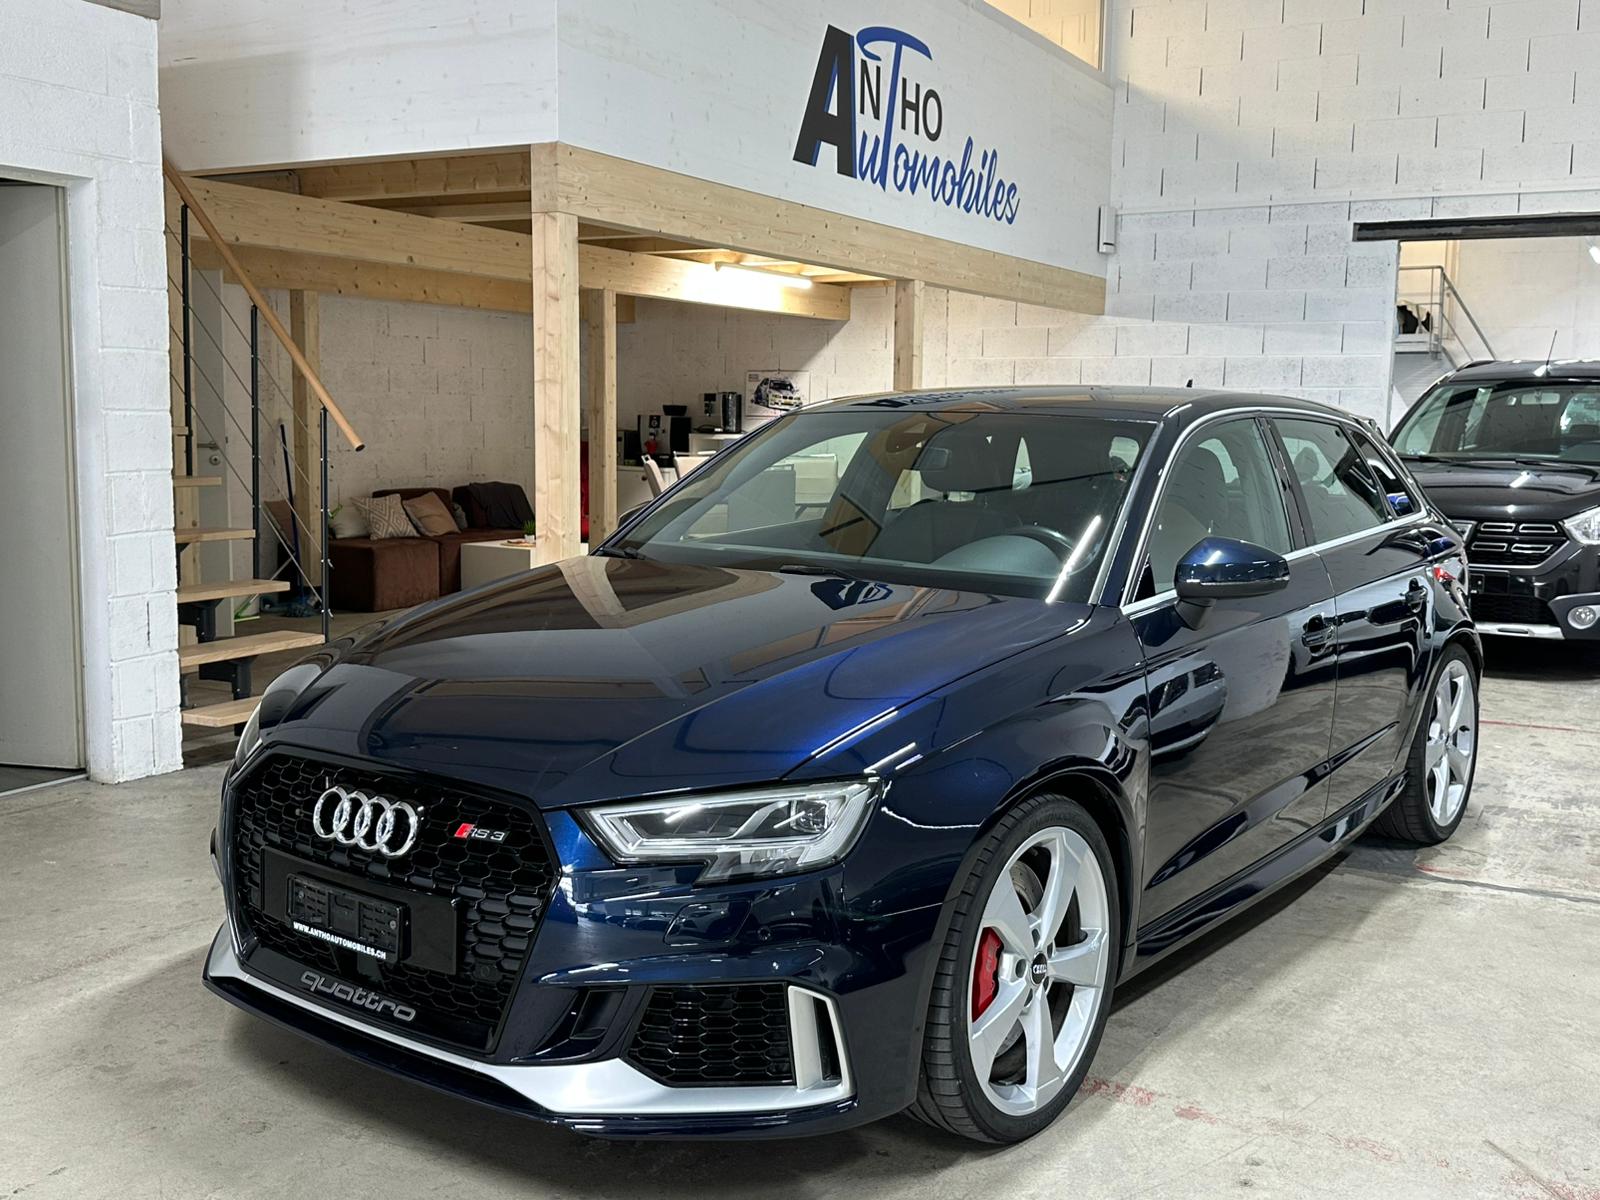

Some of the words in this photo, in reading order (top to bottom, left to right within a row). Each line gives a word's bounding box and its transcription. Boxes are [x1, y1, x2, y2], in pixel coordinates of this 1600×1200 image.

[793, 24, 943, 184] ANTHO
[293, 921, 387, 960] WWW.ANTHOAUTOMOBILES.CH
[301, 970, 416, 1022] quattro
